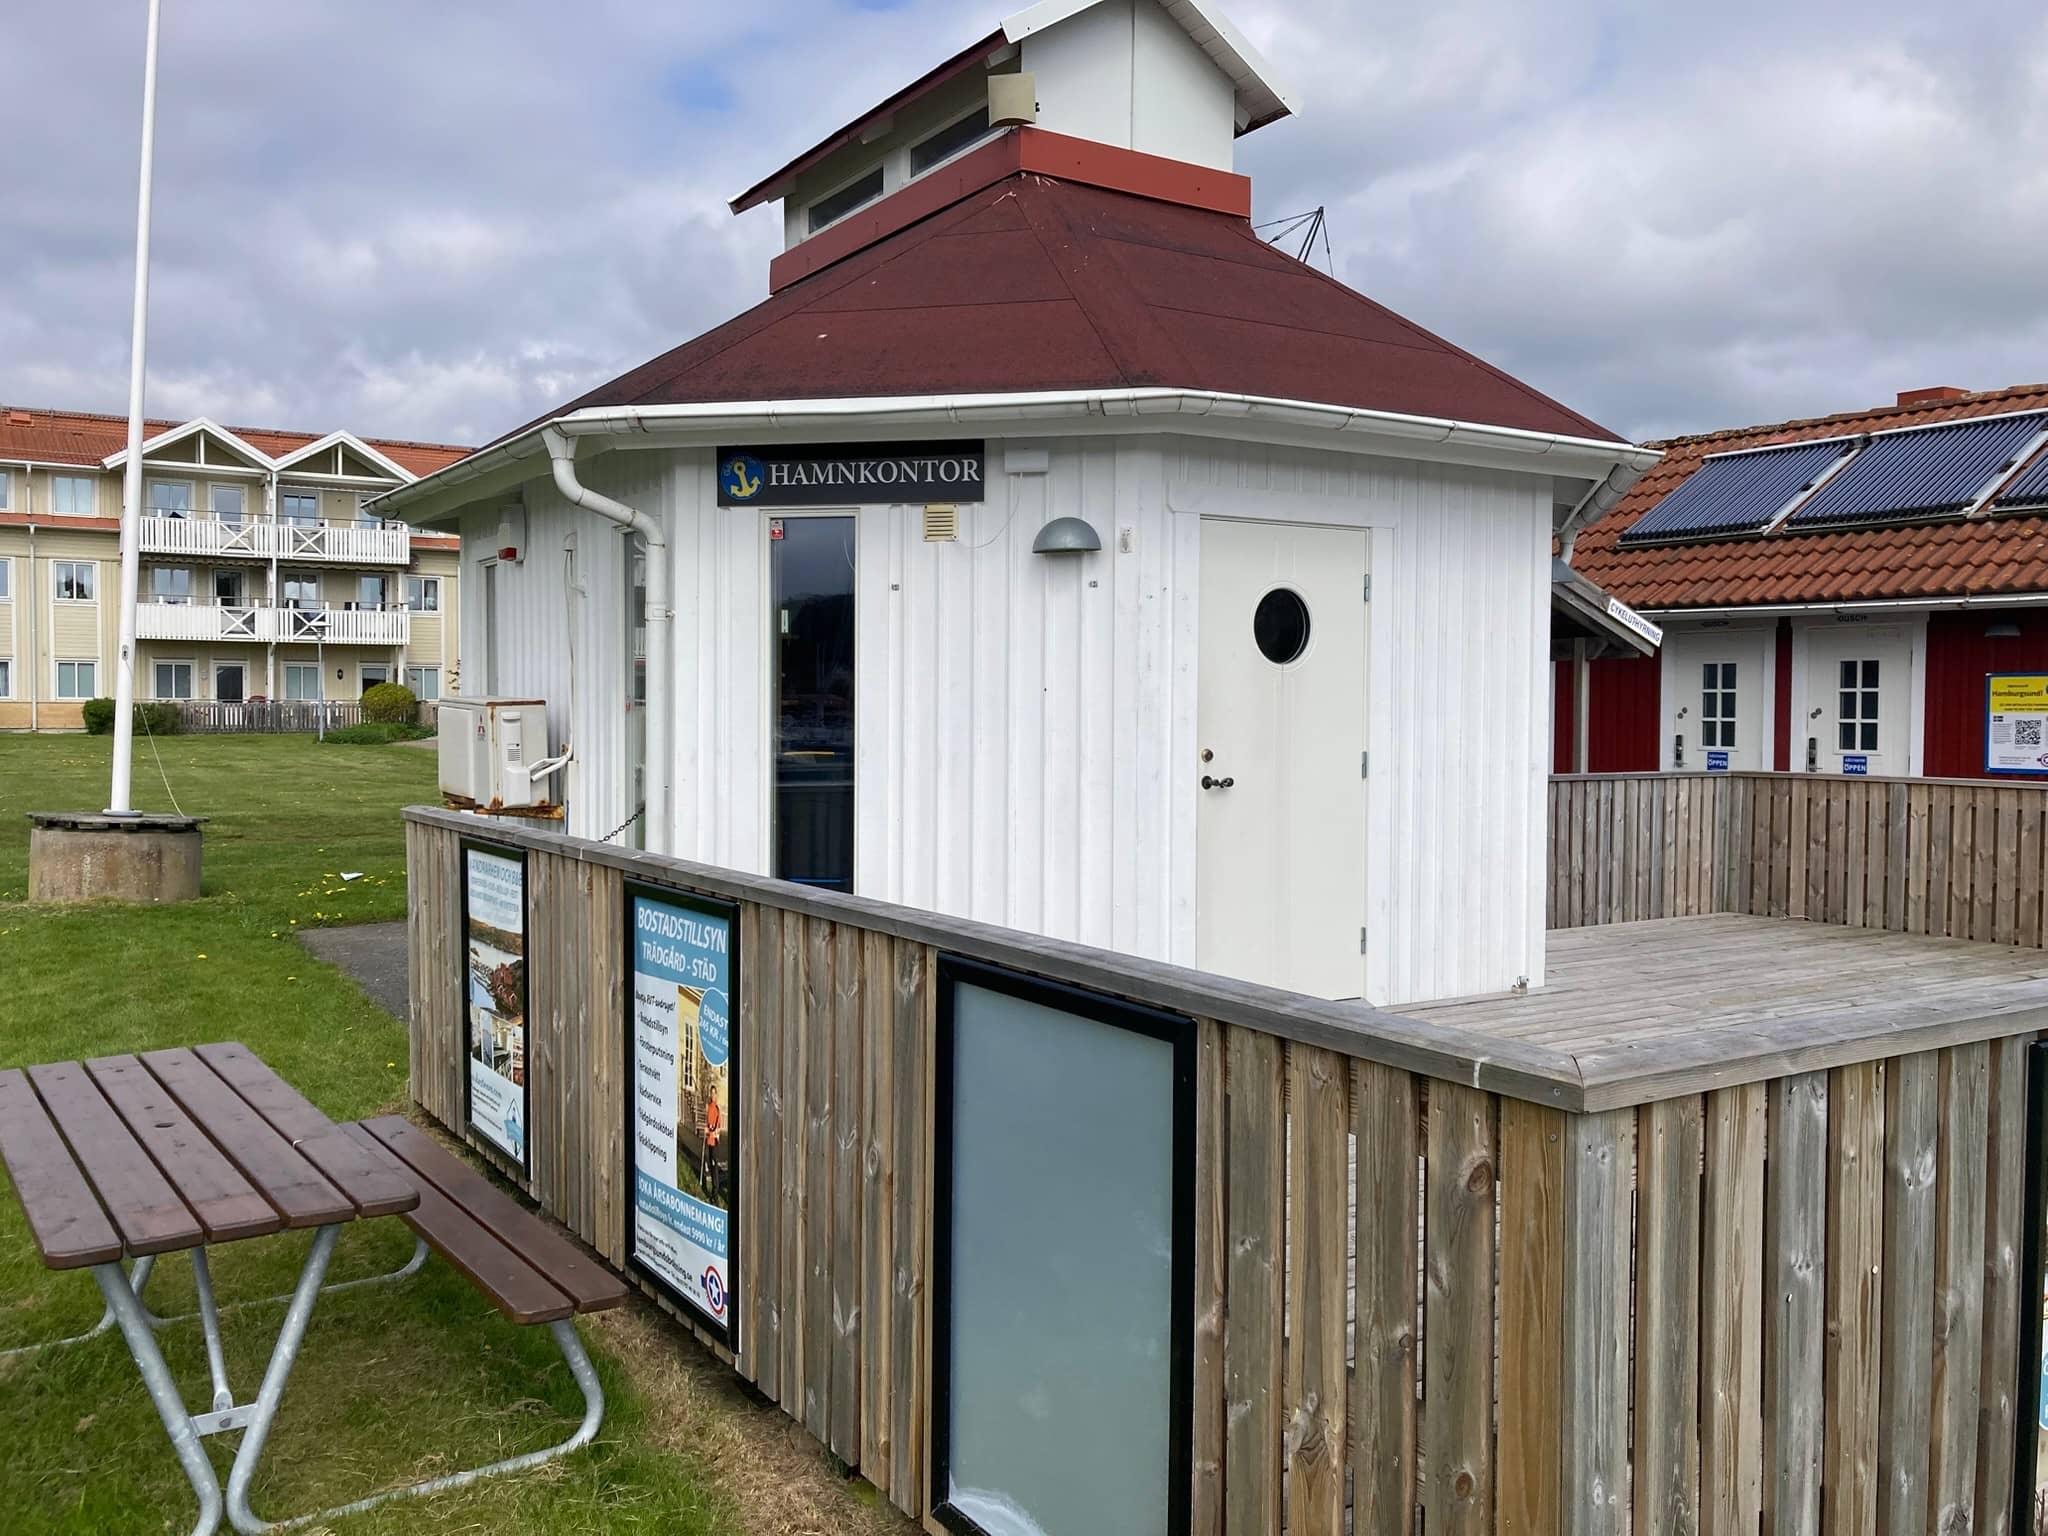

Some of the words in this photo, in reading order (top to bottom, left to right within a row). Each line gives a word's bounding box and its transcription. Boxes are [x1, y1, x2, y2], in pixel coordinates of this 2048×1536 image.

[769, 459, 981, 486] HAMNKONTOR
[1610, 602, 1661, 642] CYKELUTHYRNING
[1708, 759, 1728, 767] ÖPPEN
[1844, 763, 1866, 772] ÖPPEN
[638, 906, 727, 955] BOSTADSTILLSYN
[642, 941, 686, 973] TRÄDGÅRD
[691, 957, 717, 982] STÄD
[703, 1004, 728, 1031] ENDAST
[653, 1182, 725, 1234] ÅRSABONNEMANG!
